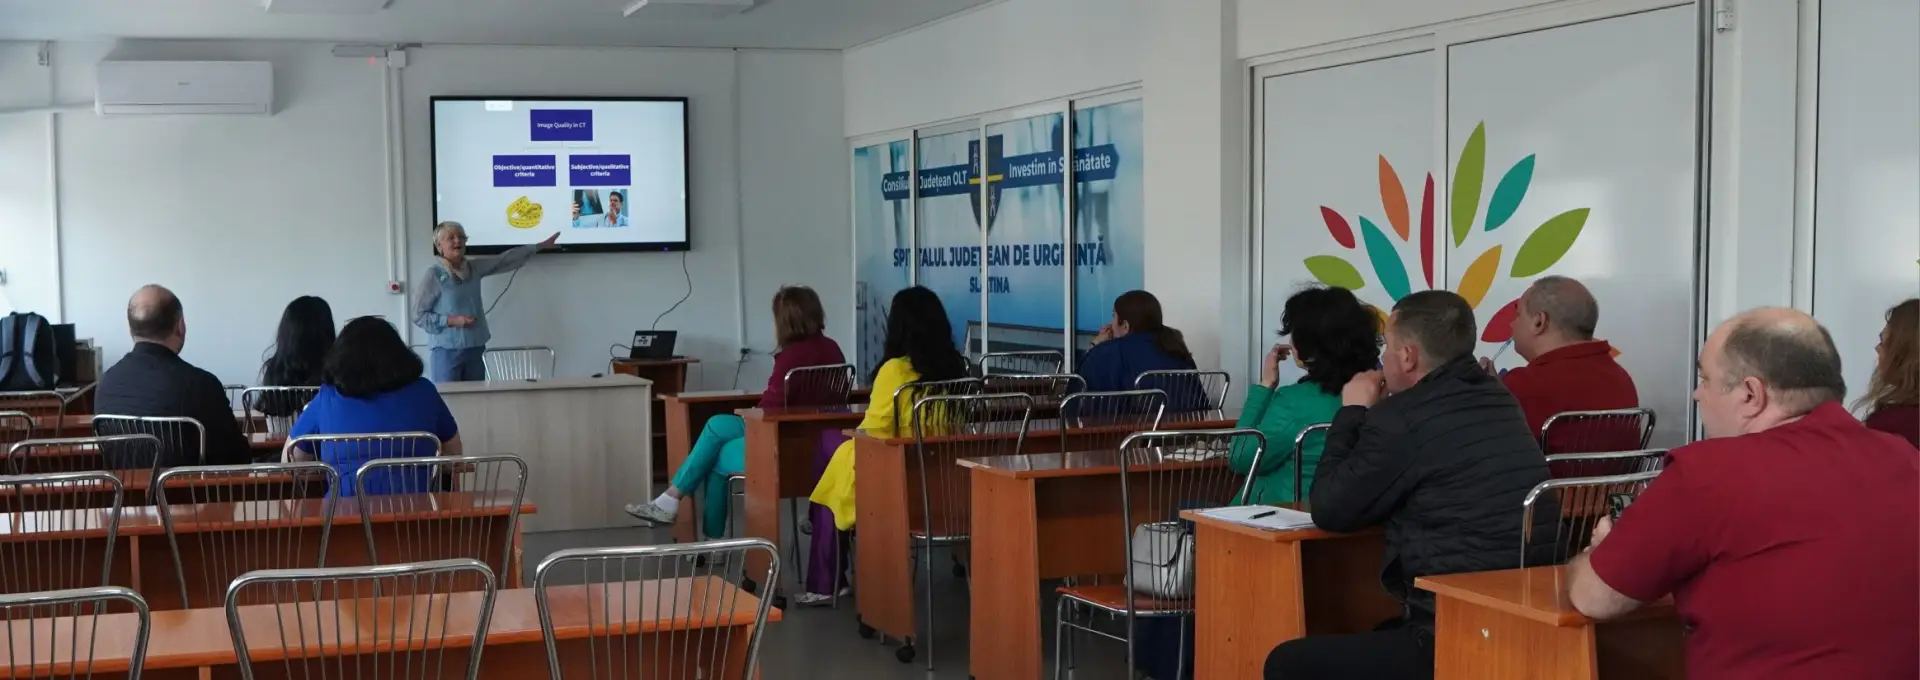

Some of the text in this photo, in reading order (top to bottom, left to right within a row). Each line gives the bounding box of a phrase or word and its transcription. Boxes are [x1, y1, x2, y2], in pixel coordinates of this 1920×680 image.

[1009, 158, 1046, 178] Investim
[1048, 158, 1057, 174] în
[952, 170, 968, 186] OLT
[1013, 244, 1030, 266] DE
[969, 276, 1010, 293] SLTINA
